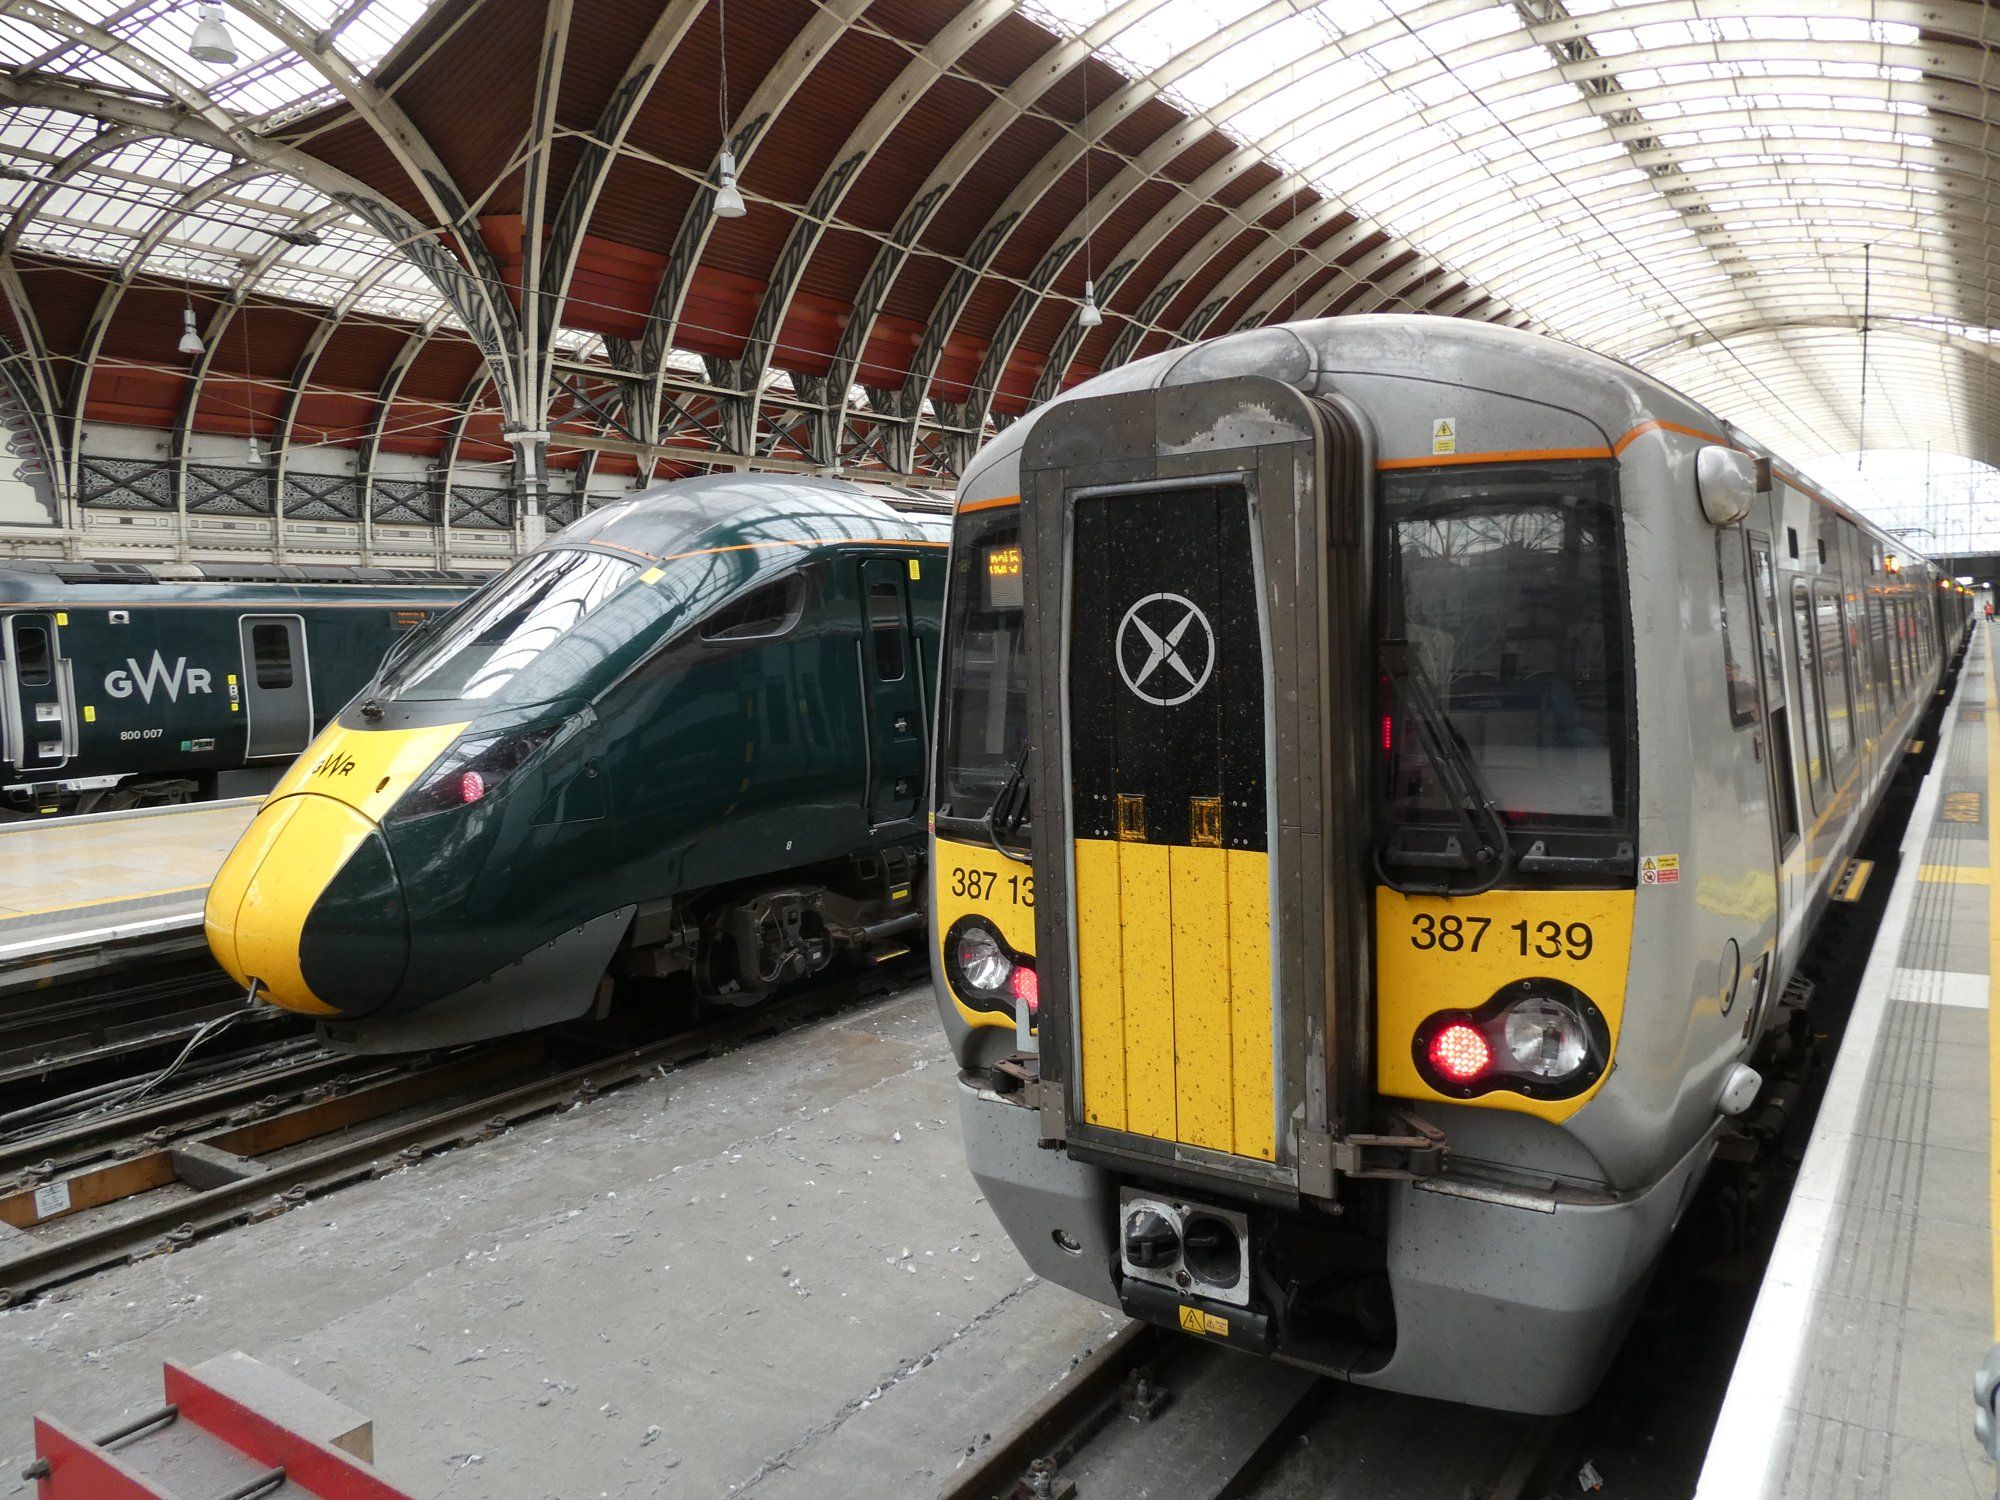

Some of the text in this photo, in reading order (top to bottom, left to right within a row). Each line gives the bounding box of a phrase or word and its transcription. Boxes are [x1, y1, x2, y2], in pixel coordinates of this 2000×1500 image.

[105, 649, 212, 704] GWR
[120, 729, 163, 741] 800 007
[786, 840, 793, 851] 8
[952, 867, 998, 901] 387
[1411, 913, 1593, 961] 387 139
